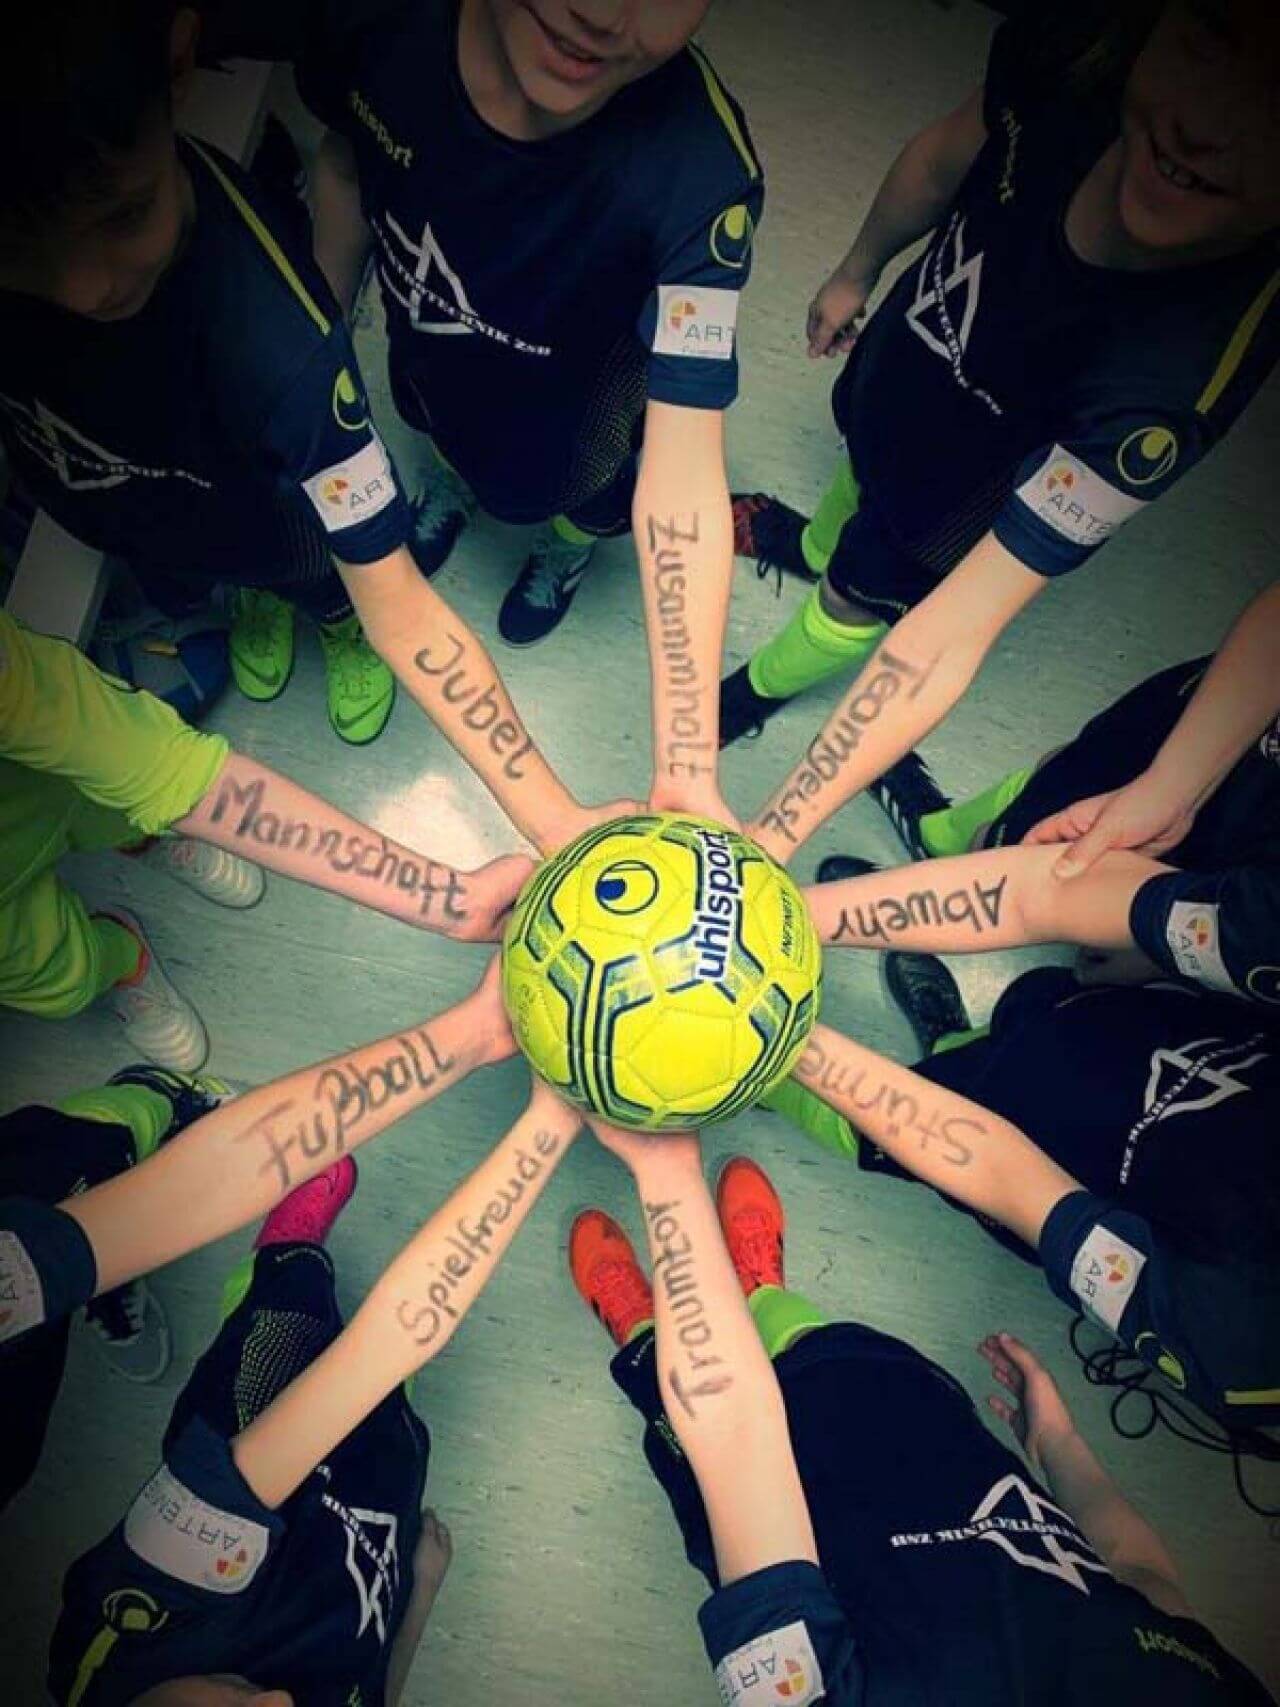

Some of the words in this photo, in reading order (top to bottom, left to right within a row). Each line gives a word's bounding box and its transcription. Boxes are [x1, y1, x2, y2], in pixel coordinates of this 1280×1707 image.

[413, 631, 534, 779] Jubel
[759, 650, 943, 843] Teamgeist
[208, 776, 469, 921] Mannschaft
[693, 830, 739, 978] uhlsport
[829, 874, 1008, 942] Abwehr
[244, 1030, 455, 1187] Fußball
[396, 1128, 559, 1344] Spielfreude
[646, 1200, 735, 1419] Traumtor
